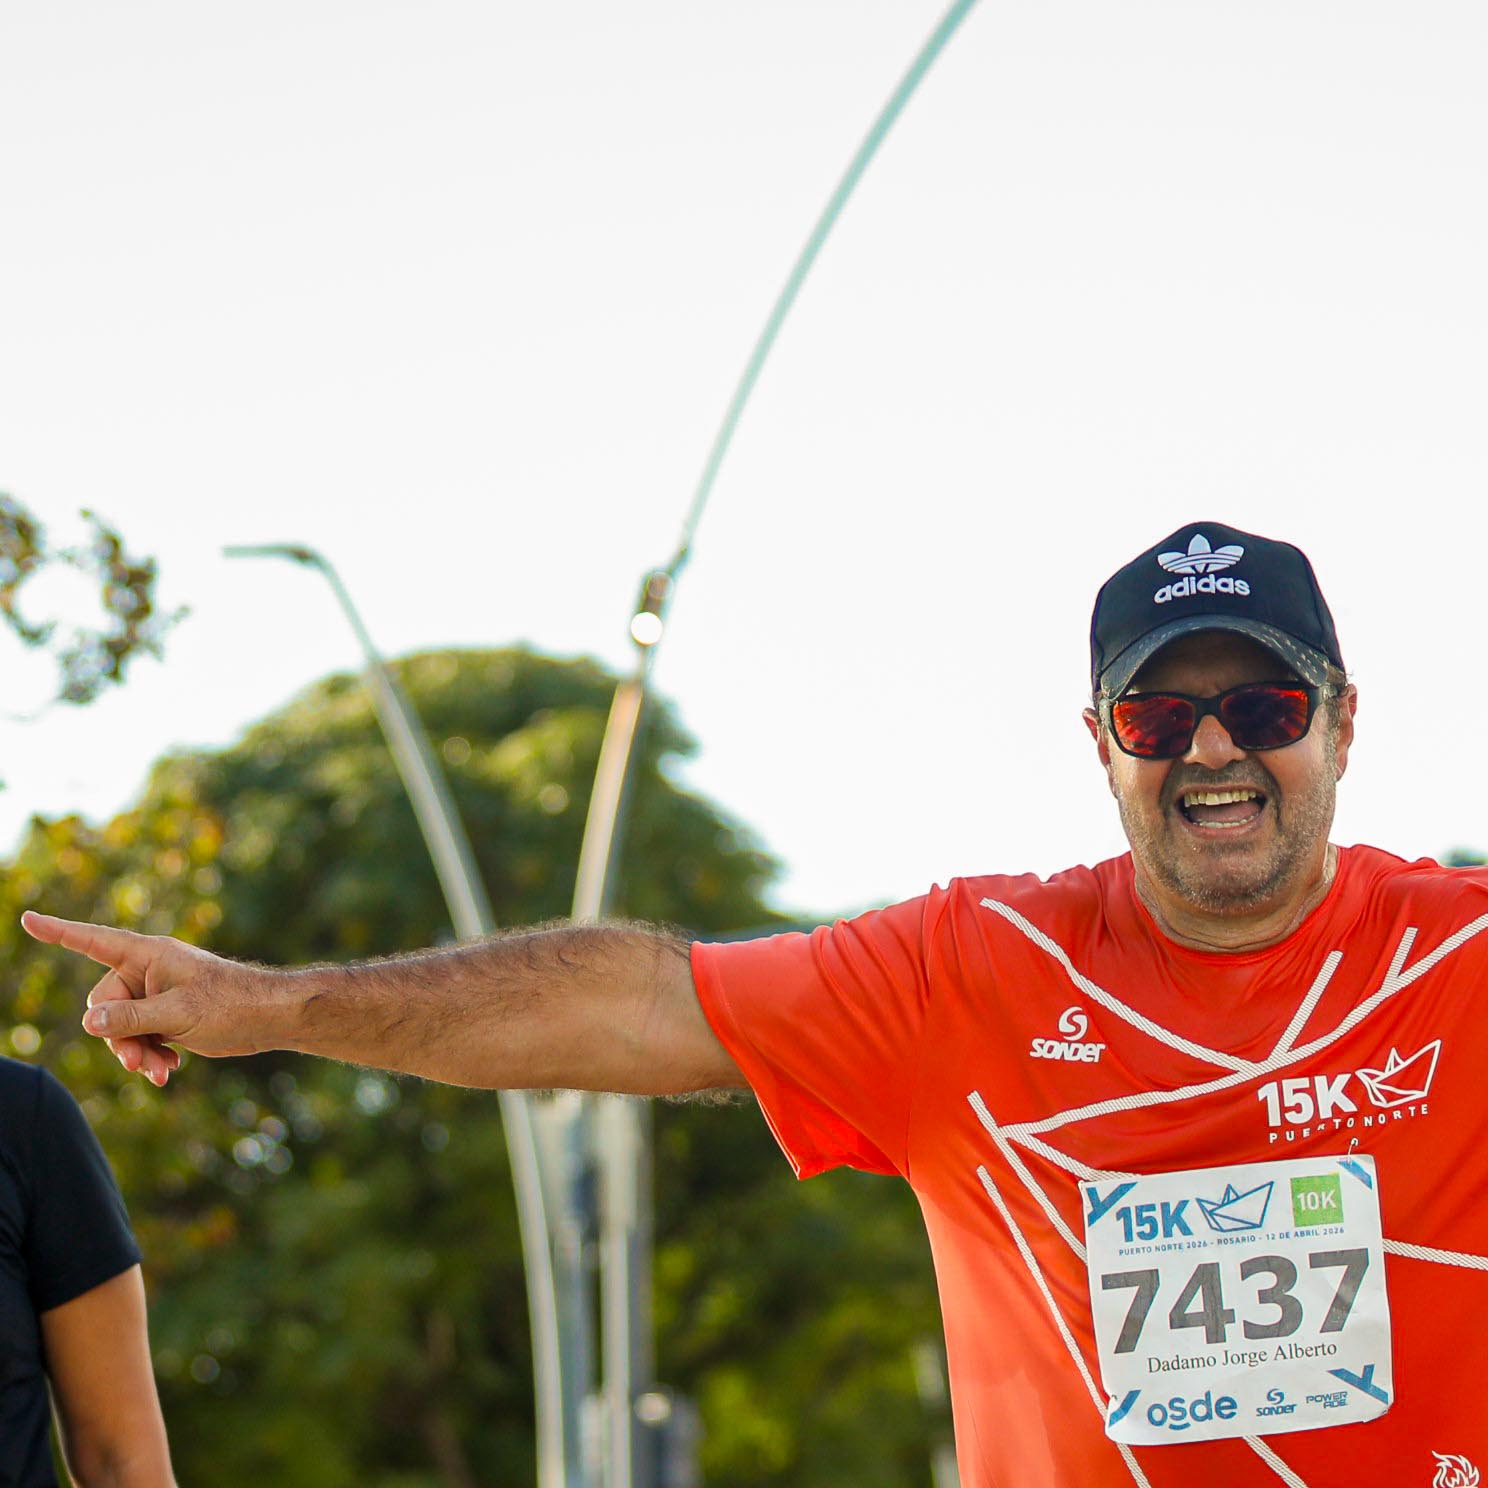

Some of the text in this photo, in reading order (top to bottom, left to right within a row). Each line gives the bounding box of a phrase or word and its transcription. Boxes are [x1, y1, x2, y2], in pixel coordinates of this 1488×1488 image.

[1154, 573, 1251, 604] adidas
[1257, 1073, 1358, 1127] 15K
[1269, 1104, 1429, 1144] PUERTO NORTE
[1297, 1189, 1338, 1212] 10K
[1115, 1199, 1194, 1243] 15K
[1118, 1245, 1153, 1257] PUERTO
[1154, 1242, 1184, 1253] NORTE
[1186, 1239, 1209, 1249] 2026
[1217, 1235, 1256, 1246] ROSARIO
[1266, 1232, 1276, 1241] 12
[1279, 1231, 1291, 1240] DE
[1293, 1230, 1320, 1239] ABRIL
[1323, 1227, 1345, 1236] 2026
[1101, 1247, 1370, 1354] 7437
[1147, 1343, 1338, 1374] Dadamo Jorge Alberto
[1146, 1389, 1239, 1428] osde
[1305, 1390, 1349, 1404] POWER
